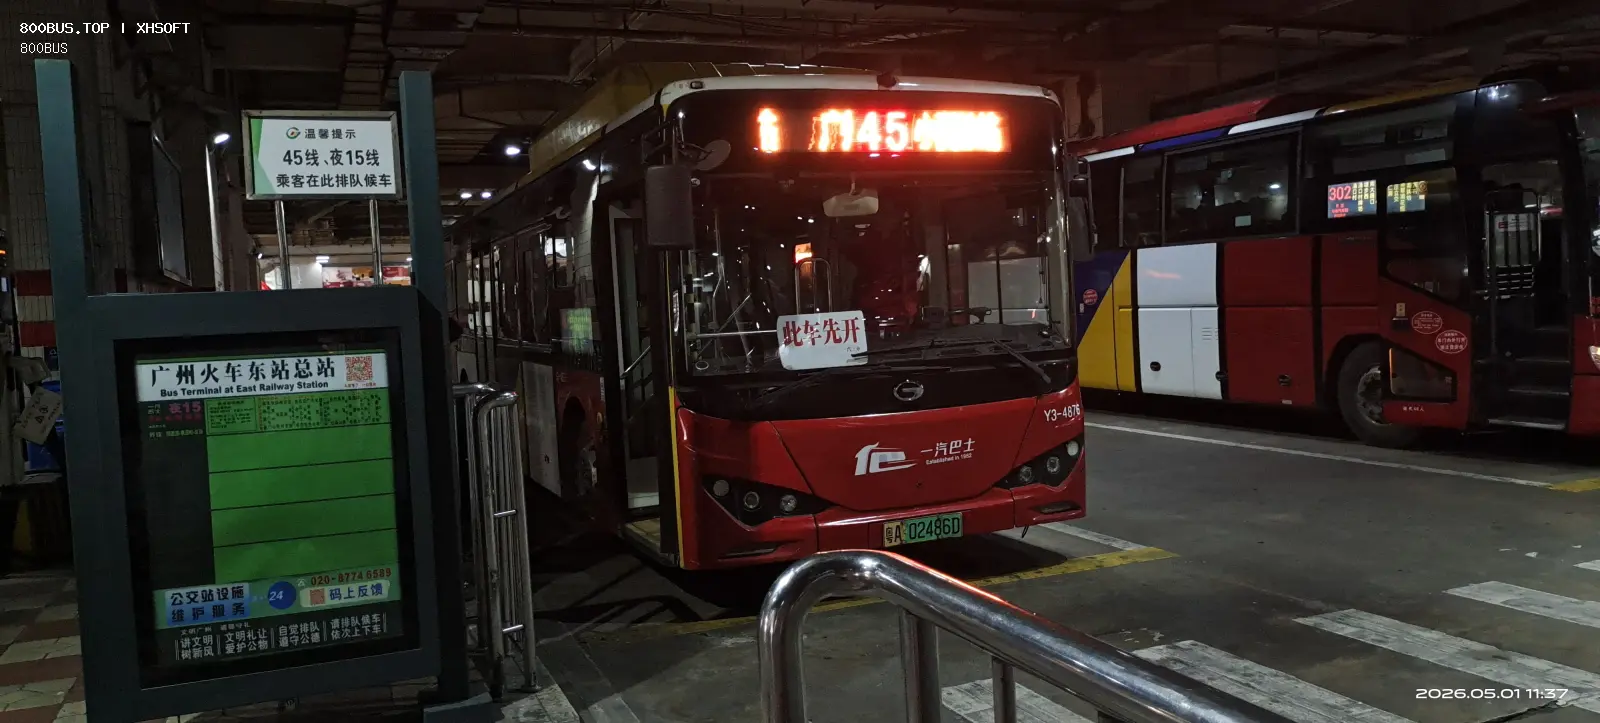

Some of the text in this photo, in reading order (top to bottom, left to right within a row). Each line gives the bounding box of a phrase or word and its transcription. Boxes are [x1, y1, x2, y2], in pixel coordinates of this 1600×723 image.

[304, 128, 357, 140] 温馨提示
[282, 148, 380, 167] 45线、夜15线
[276, 173, 392, 188] 乘客在此排队候车
[1328, 185, 1352, 201] 302
[782, 316, 860, 347] 此车先开
[151, 357, 336, 387] 广州火车东站总站
[160, 380, 329, 397] Bus Terminal at East Railway Station
[1043, 403, 1080, 422] Y3-4876
[920, 438, 976, 457] 一汽巴士
[170, 585, 245, 606] 公交站设施
[269, 590, 284, 601] 24
[329, 583, 383, 600] 码上反馈
[171, 602, 245, 622] 维护服务
[278, 621, 320, 636] 自觉排队
[330, 613, 381, 629] 请排队候车
[224, 628, 268, 644] 文明礼让
[279, 631, 321, 648] 遵守公德
[331, 624, 382, 640] 依次上下车
[180, 634, 214, 648] 讲文明
[225, 640, 269, 654] 爱护公物
[181, 645, 215, 660] 树新风
